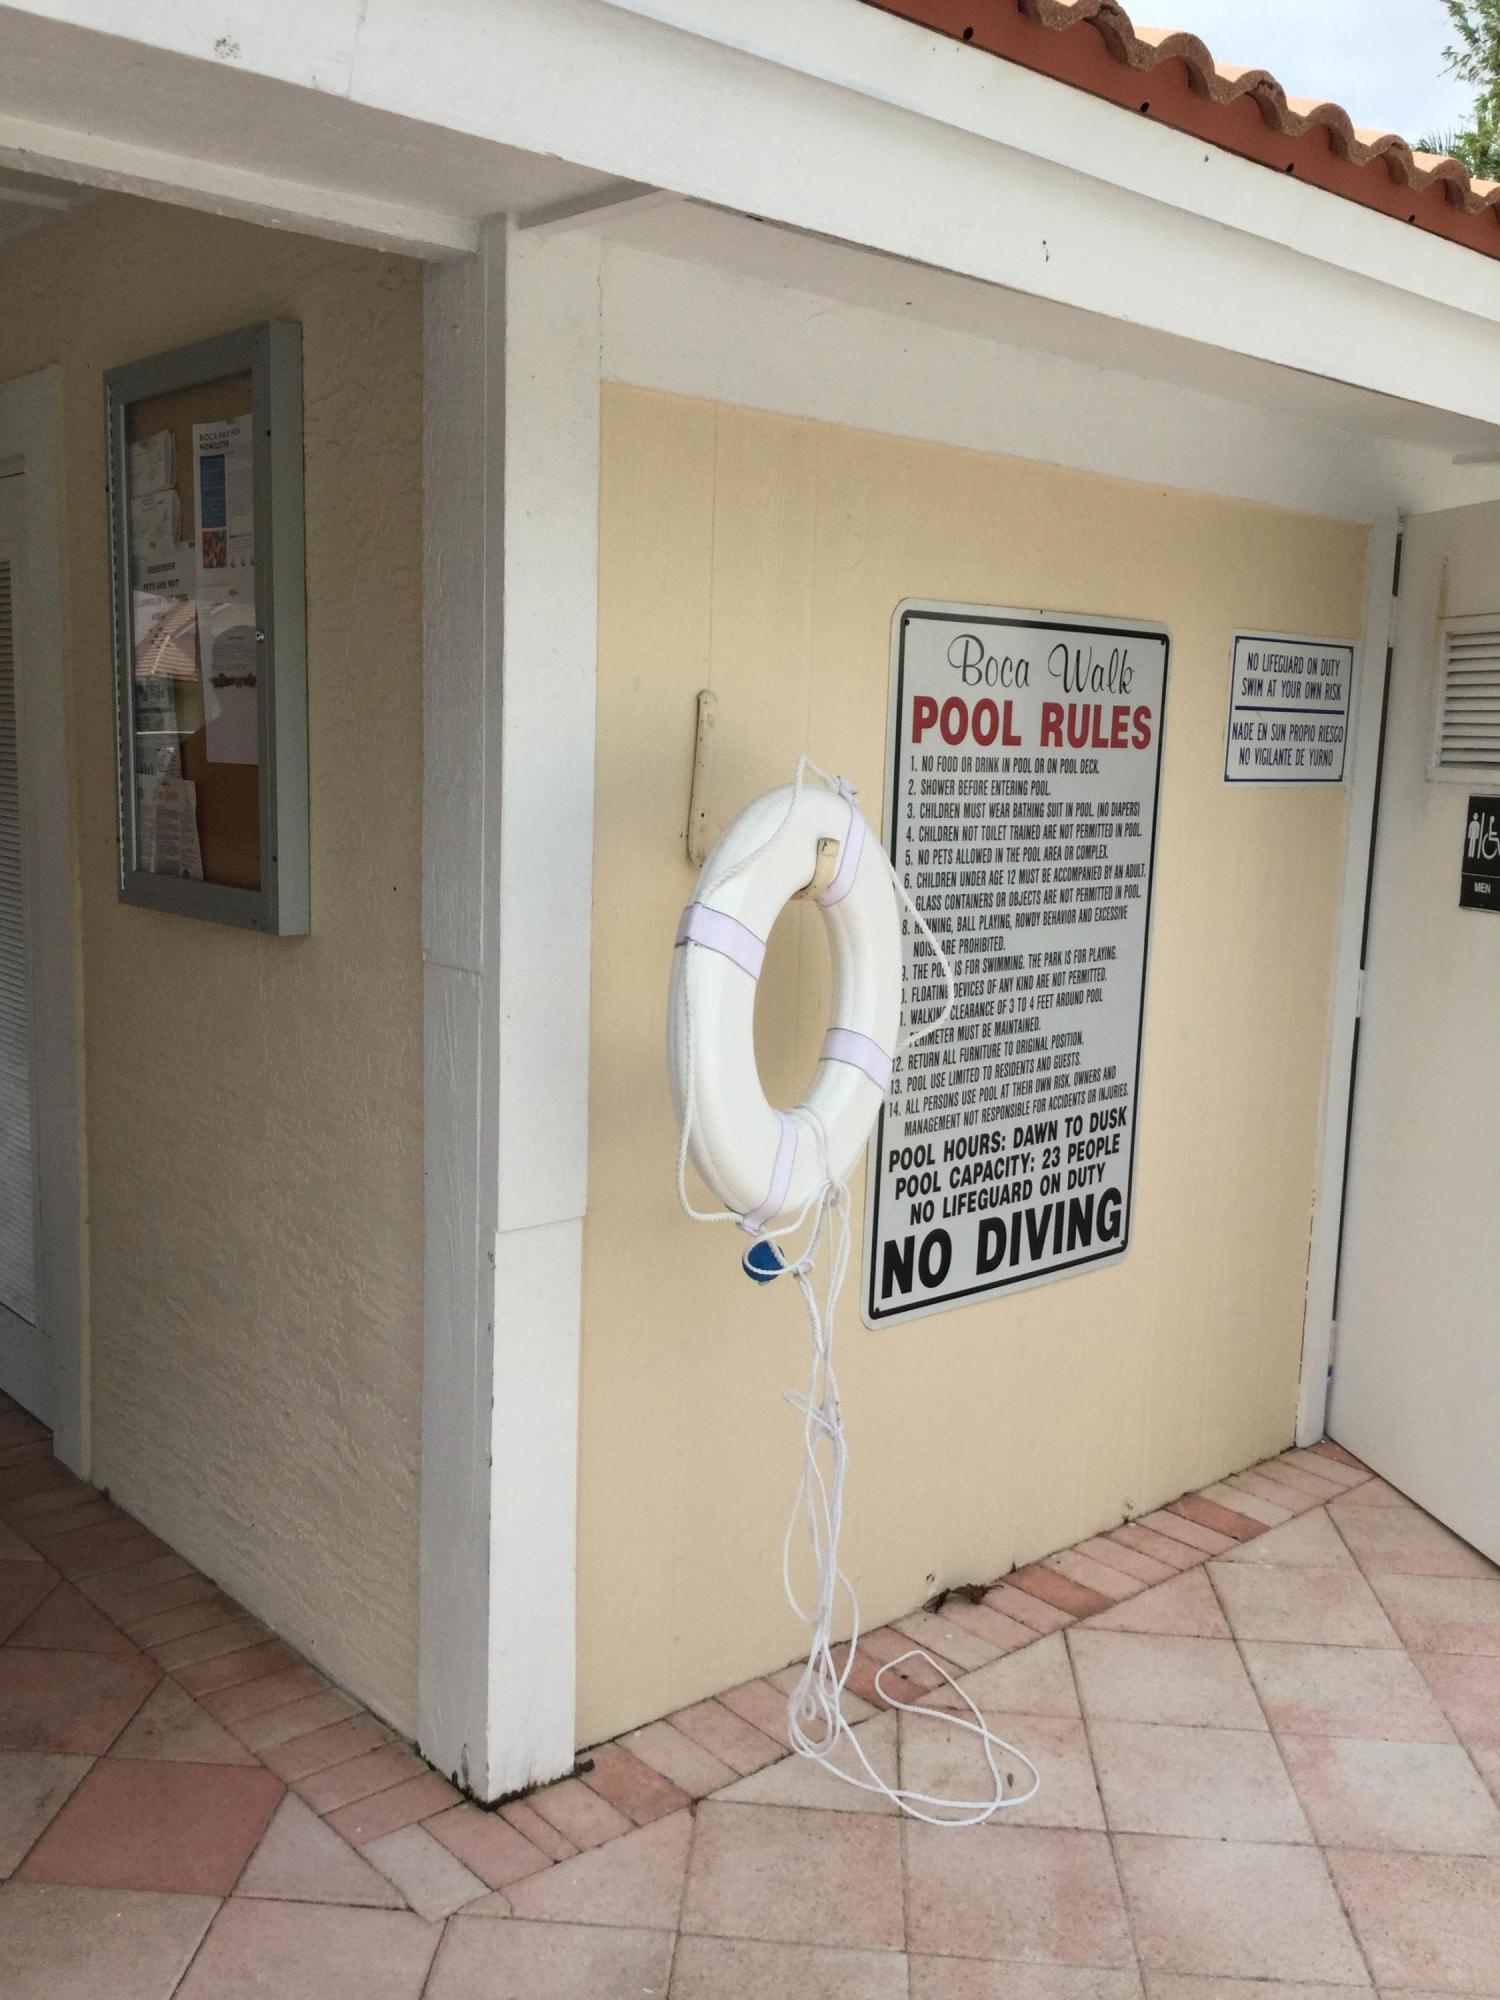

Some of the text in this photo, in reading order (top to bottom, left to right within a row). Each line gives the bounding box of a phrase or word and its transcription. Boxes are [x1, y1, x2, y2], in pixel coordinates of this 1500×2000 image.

[947, 634, 1133, 694] Boca Walk
[1247, 652, 1341, 676] NO LIFEGUARD ON DUTY
[1241, 677, 1342, 701] SWIM AT YOUR OWN RISK
[911, 696, 1152, 750] POOL RULES
[1232, 722, 1343, 743] NADE EN SUN PROPIO RIESGO
[922, 755, 933, 772] NO
[937, 756, 958, 772] FOOD
[976, 757, 999, 772] DRINK
[1013, 757, 1032, 773] POOL
[1060, 758, 1077, 774] POOL
[1239, 747, 1250, 765] NO
[1255, 748, 1292, 766] VIGILANTE
[1296, 748, 1304, 766] DE
[921, 779, 955, 795] SHOWER
[958, 780, 988, 795] BEFORE
[991, 780, 1028, 796] ENTERING
[920, 802, 960, 818] CHILDREN
[964, 803, 986, 818] MUST
[989, 803, 1010, 818] WEAR
[1013, 802, 1044, 818] BATHING
[1047, 802, 1064, 817] SUIT
[919, 826, 959, 842] CHILDREN
[962, 826, 978, 841] NOT
[981, 825, 1007, 840] TOILET
[1010, 825, 1040, 840] TRAINED
[1043, 824, 1057, 839] ARE
[1059, 824, 1074, 839] NOT
[1076, 823, 1113, 838] PERMITTED
[918, 849, 929, 865] NO
[933, 848, 953, 865] PETS
[956, 848, 992, 864] ALLOWED
[1006, 847, 1020, 862] THE
[1023, 846, 1040, 862] POOL
[1044, 846, 1061, 861] AREA
[917, 872, 956, 888] CHILDREN
[960, 870, 986, 887] UNDER
[988, 870, 1004, 885] AGE
[1007, 869, 1016, 884] 12
[1019, 868, 1039, 884] MUST
[1042, 868, 1051, 883] BE
[1053, 866, 1102, 882] ACCOMPANIED
[1474, 882, 1491, 894] MEN
[916, 895, 942, 911] GLASS
[945, 892, 993, 910] CONTAINERS
[1009, 890, 1041, 906] OBJECTS
[1043, 889, 1057, 904] ARE
[1060, 888, 1074, 903] NOT
[1076, 886, 1113, 902] PERMITTED
[957, 916, 975, 932] BALL
[1015, 912, 1041, 927] ROWDY
[1043, 909, 1076, 926] BEHAVIOR
[1078, 908, 1092, 923] AND
[1095, 905, 1128, 921] EXCESSIVE
[913, 963, 928, 980] THE
[965, 959, 979, 975] FOR
[1028, 953, 1042, 968] THE
[1044, 950, 1062, 967] PARK
[1074, 949, 1086, 964] FOR
[954, 979, 984, 998] DEVICES
[999, 977, 1014, 993] ANY
[1016, 975, 1034, 991] KIND
[1036, 973, 1050, 988] ARE
[1052, 971, 1066, 987] NOT
[950, 988, 1103, 1020] CLEARANCE 3 TO 4 FEET AROUND POOL
[958, 1024, 979, 1041] MUST
[982, 1023, 991, 1038] BE
[908, 1051, 939, 1070] RETURN
[943, 1049, 956, 1065] ALL
[960, 1042, 1001, 1063] FURNITURE
[1004, 1041, 1013, 1056] TO
[1016, 1036, 1048, 1054] ORIGINAL
[907, 1075, 927, 1092] POOL
[931, 1072, 946, 1088] USE
[949, 1067, 980, 1086] LIMITED
[983, 1065, 992, 1080] TO
[995, 1059, 1034, 1079] RESIDENTS
[1037, 1056, 1051, 1072] AND
[905, 1098, 920, 1114] ALL
[923, 1092, 959, 1112] PERSONS
[962, 1089, 976, 1106] USE
[979, 1085, 997, 1102] POOL
[1001, 1083, 1010, 1099] AT
[1013, 1080, 1033, 1096] THEIR
[1035, 1076, 1051, 1093] OWN
[1073, 1068, 1101, 1086] OWNERS
[1103, 1065, 1116, 1080] AND
[904, 1113, 961, 1136] MANAGEMENT
[964, 1110, 979, 1126] NOT
[982, 1100, 1030, 1123] RESPONSIBLE
[1033, 1098, 1046, 1114] FOR
[1048, 1091, 1085, 1111] ACCIDENTS
[889, 1106, 1127, 1173] POOL HOURS: DAWN TO DUSK
[895, 1133, 1120, 1200] POOL CAPACITY: 23 PEOPLE
[910, 1162, 1106, 1226] NO LIFEGUARD ON DUTY
[881, 1187, 1122, 1299] NO DIVING
